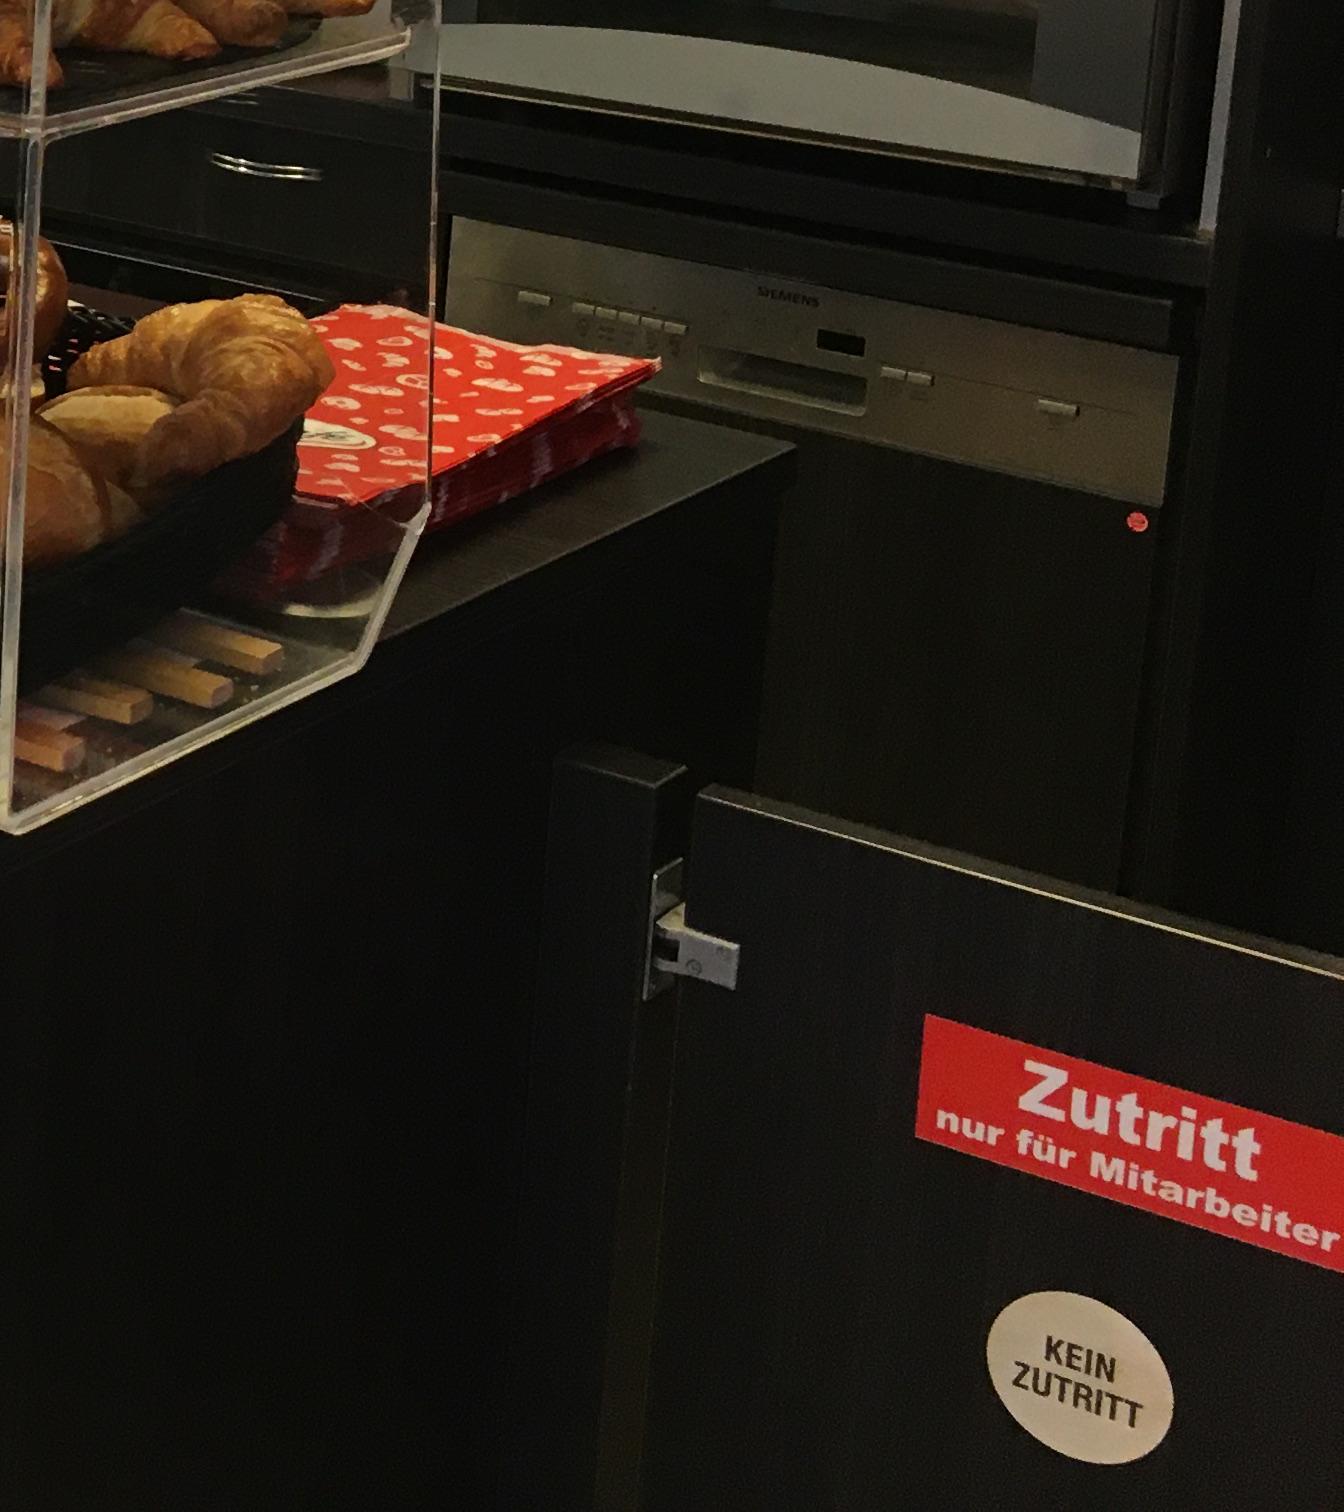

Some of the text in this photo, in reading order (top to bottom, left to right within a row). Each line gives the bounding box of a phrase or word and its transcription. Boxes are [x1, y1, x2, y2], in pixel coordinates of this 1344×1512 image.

[757, 287, 820, 307] SIEMENS
[1018, 1059, 1261, 1183] Zutritt
[936, 1108, 1340, 1253] nur für Mitarbeiter
[1044, 1335, 1117, 1384] KEIN
[1012, 1361, 1144, 1429] ZUTRITT
